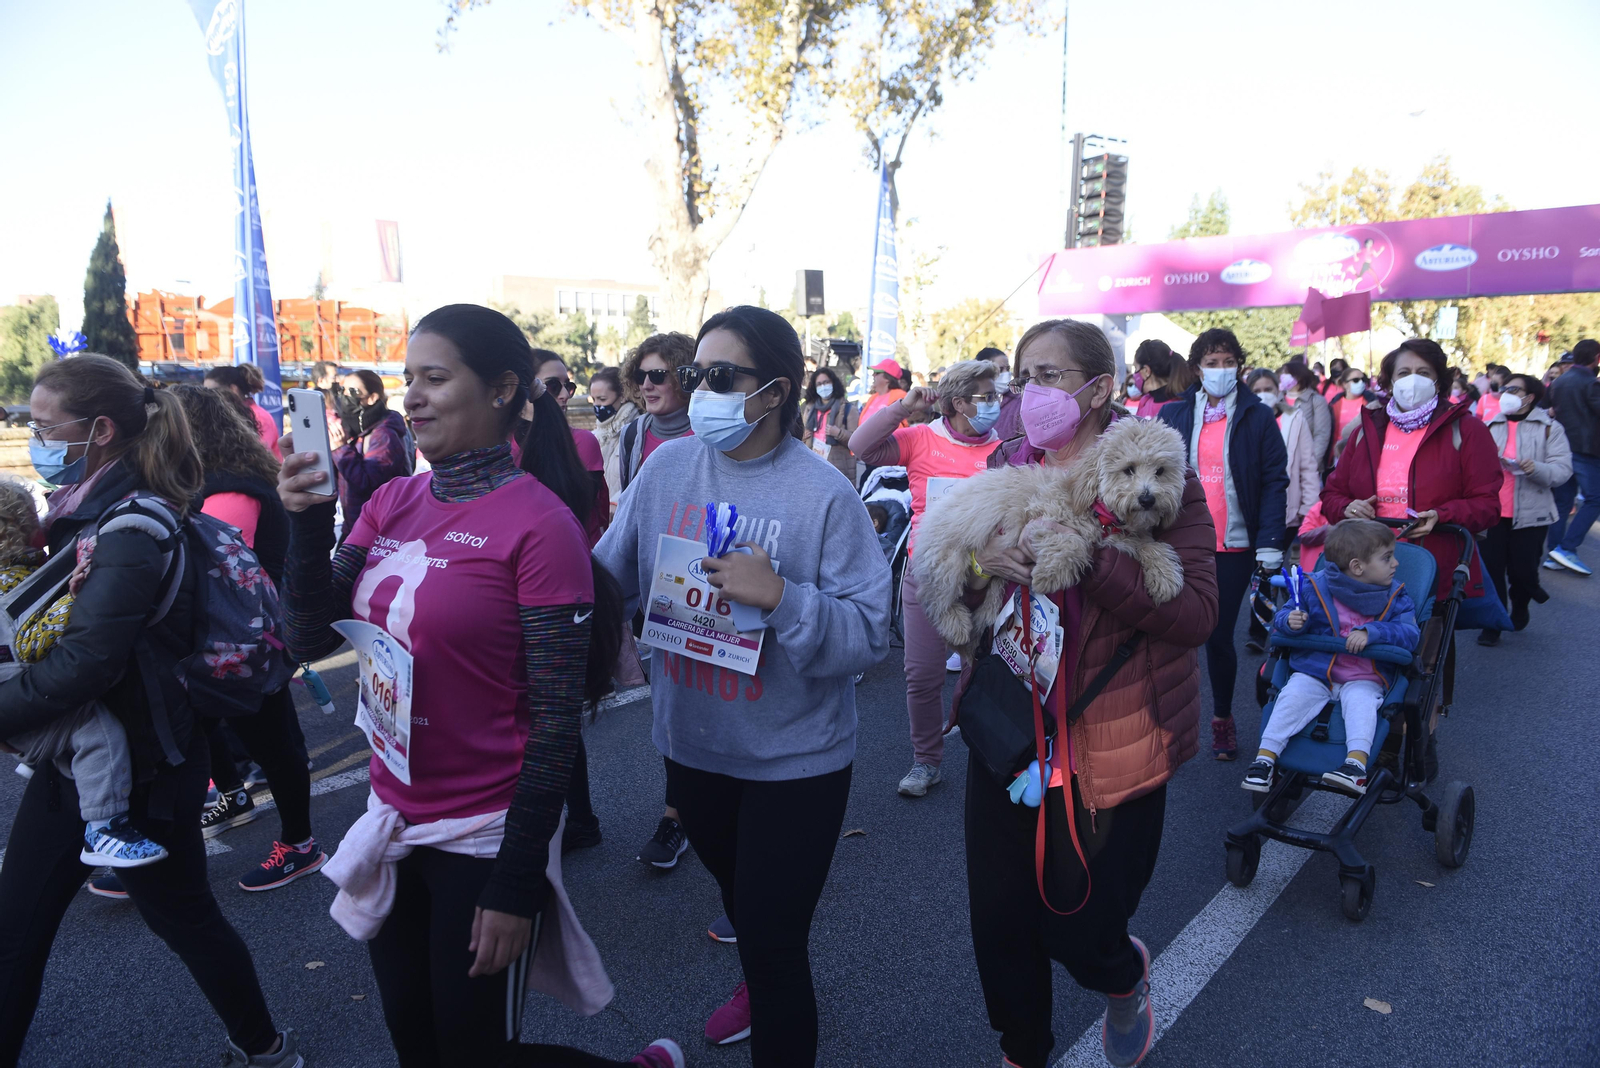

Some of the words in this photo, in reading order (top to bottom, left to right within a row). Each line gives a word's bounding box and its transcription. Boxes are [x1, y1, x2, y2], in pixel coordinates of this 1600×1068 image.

[1497, 245, 1560, 262] OYSHO
[1114, 276, 1151, 288] ZURICH
[1164, 271, 1209, 286] OYSHO
[686, 588, 732, 616] 016
[692, 614, 716, 628] 4420
[647, 628, 682, 646] OYSHO
[667, 619, 696, 634] CARRERA
[695, 626, 705, 635] DE
[706, 628, 715, 638] LA
[716, 631, 741, 645] MUJER
[1002, 638, 1018, 659] 4030
[727, 652, 750, 664] ZURICH
[372, 672, 391, 712] 016
